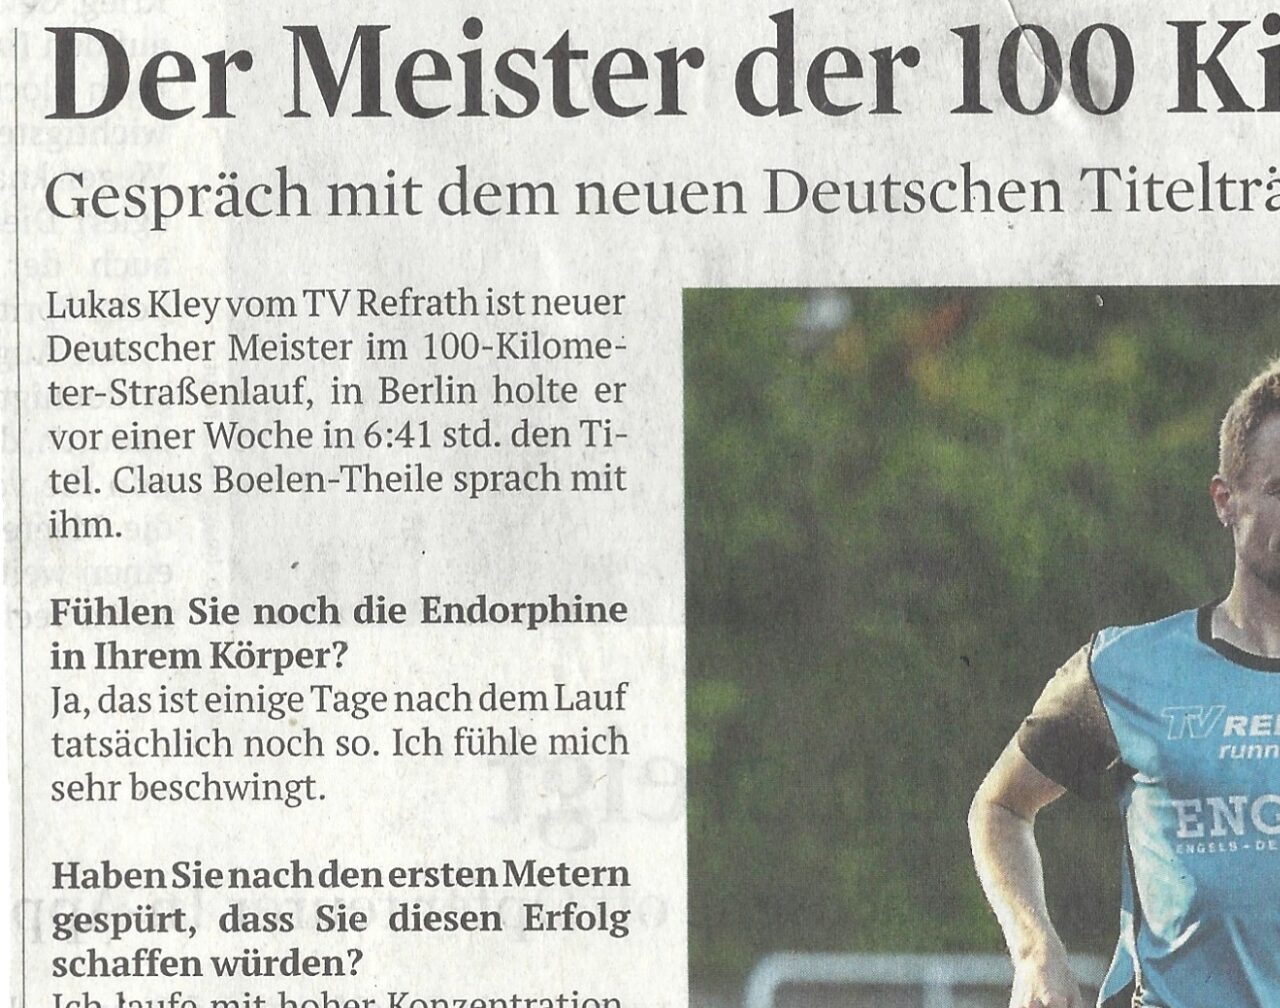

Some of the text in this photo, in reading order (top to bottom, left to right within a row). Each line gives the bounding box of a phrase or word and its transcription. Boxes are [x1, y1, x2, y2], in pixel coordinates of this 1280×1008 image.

[44, 26, 254, 121] Der
[282, 16, 705, 120] Meister
[734, 7, 921, 117] der
[949, 22, 1135, 116] 100
[45, 165, 312, 232] Gespräch
[327, 169, 423, 216] mit
[438, 164, 559, 216] dem
[575, 181, 747, 215] neuen
[763, 161, 1065, 214] Deutschen
[46, 286, 626, 325] Lukas Kley vom TV Refrath ist neuer
[47, 330, 627, 363] Deutscher Meister im 100-Kilome-
[47, 374, 627, 411] ter-Straßenlauf, in Berlin holte er
[49, 508, 122, 538] ihm.
[50, 593, 628, 631] Fühlen Sie noch die Endorphine
[51, 640, 349, 676] in Ihrem Körper?
[52, 858, 631, 890] Haben Sie nach den ersten Metern
[52, 901, 632, 941] gespürt, dass Sie diesen Erfolg
[52, 947, 364, 978] schaffen würden?
